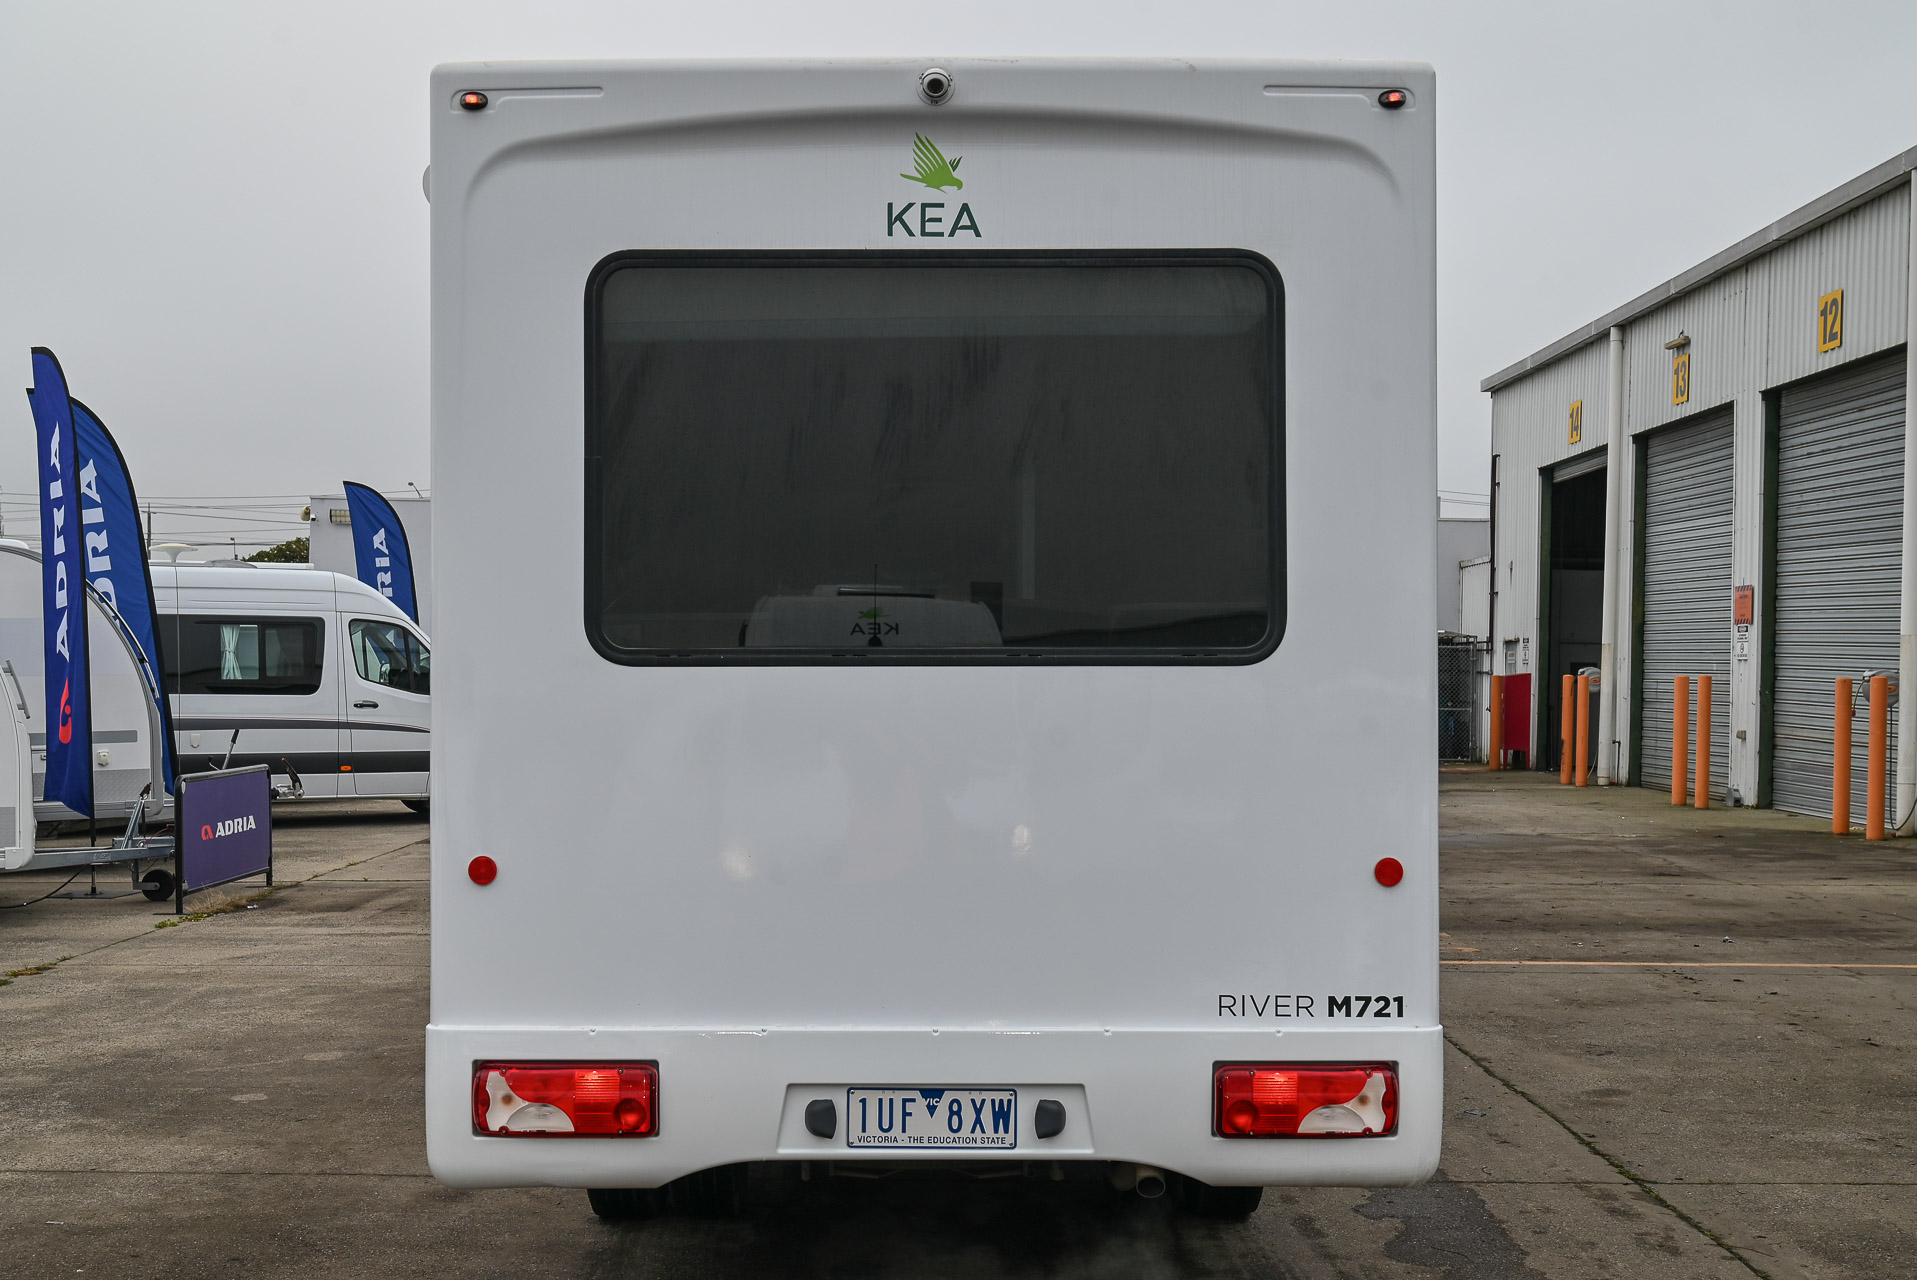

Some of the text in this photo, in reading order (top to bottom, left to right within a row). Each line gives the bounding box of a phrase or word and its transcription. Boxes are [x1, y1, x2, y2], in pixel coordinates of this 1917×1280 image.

[887, 202, 982, 237] KEA
[1820, 297, 1839, 345] 12
[1674, 360, 1687, 399] 13
[1569, 406, 1579, 439] 14
[50, 421, 70, 663] ADRIA
[80, 458, 120, 630] DRIA
[373, 527, 393, 598] RIA
[215, 815, 256, 838] ADRIA
[1218, 994, 1404, 1018] RIVER M721
[858, 1097, 1013, 1134] 1UF 8XW
[924, 1098, 941, 1107] VIC
[857, 1135, 899, 1144] VICTORIA
[907, 1136, 925, 1144] THE
[927, 1136, 979, 1145] EDUCATION
[980, 1136, 1006, 1145] STATE
